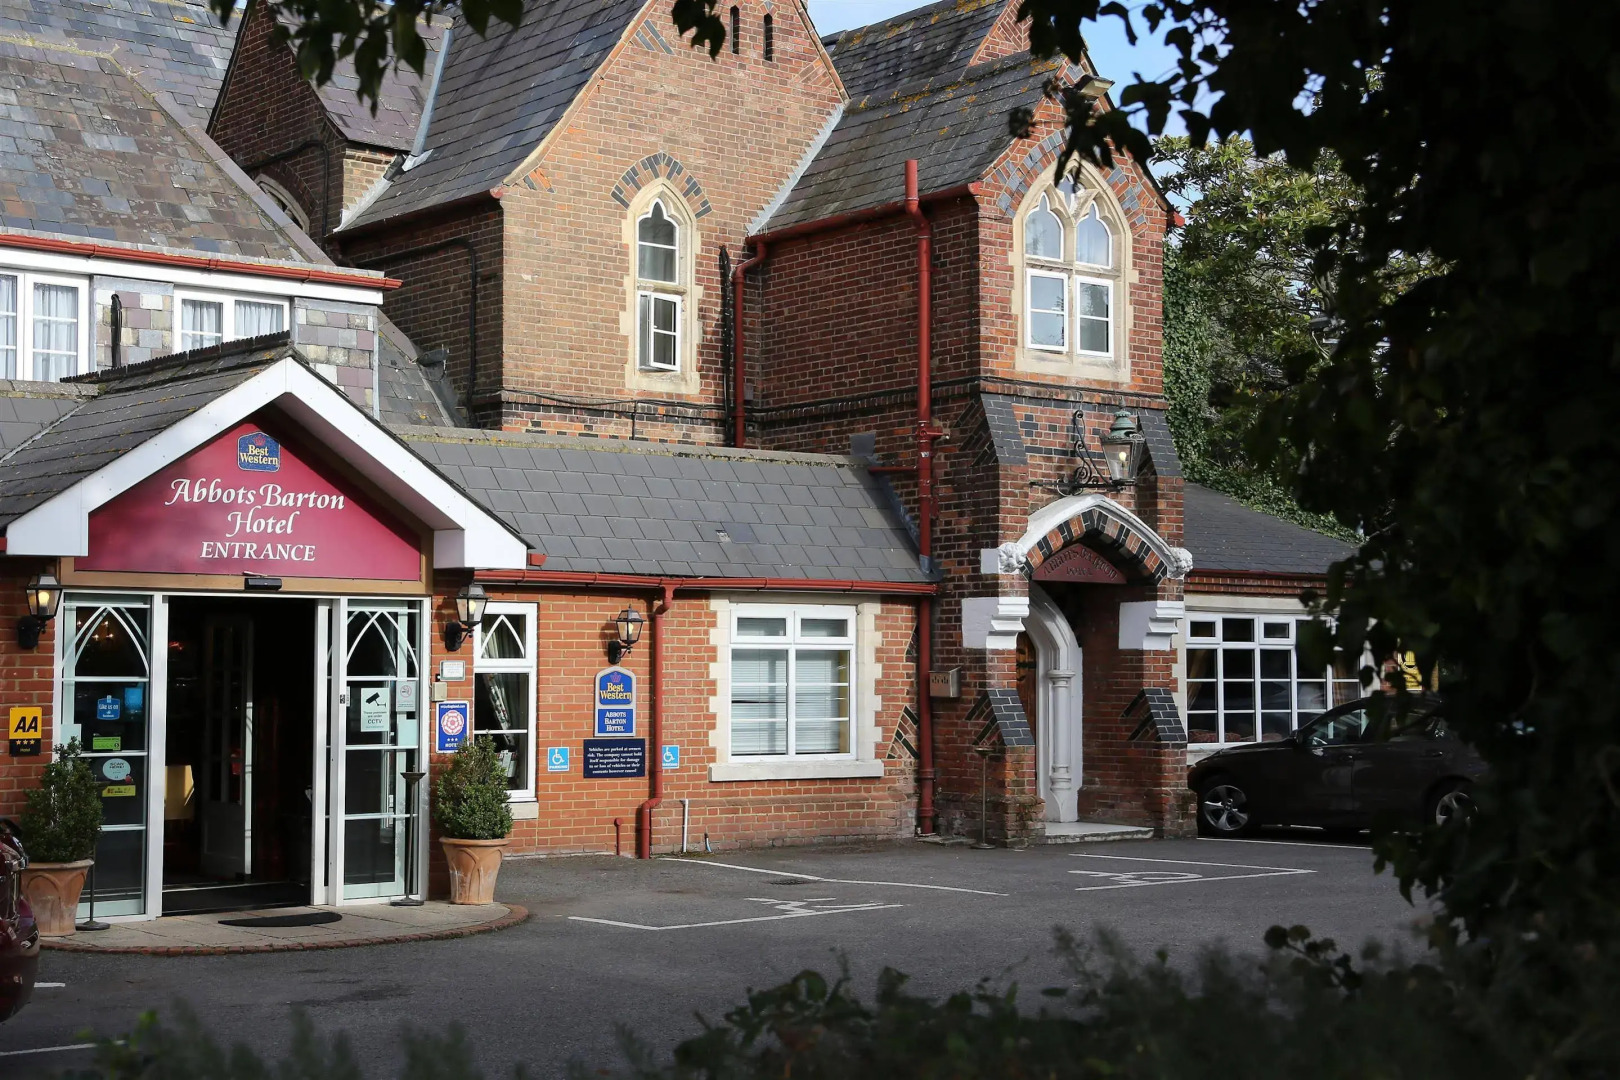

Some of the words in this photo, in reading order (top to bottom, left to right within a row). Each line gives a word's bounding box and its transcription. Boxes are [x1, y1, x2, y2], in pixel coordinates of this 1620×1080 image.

[248, 444, 269, 456] Best
[240, 452, 279, 467] Western
[164, 478, 256, 506] Abbots
[259, 483, 345, 510] Barton
[225, 505, 300, 538] Hotel
[200, 541, 316, 562] ENTRANCE
[607, 682, 624, 692] Best
[600, 690, 632, 701] Western
[14, 716, 38, 733] AA
